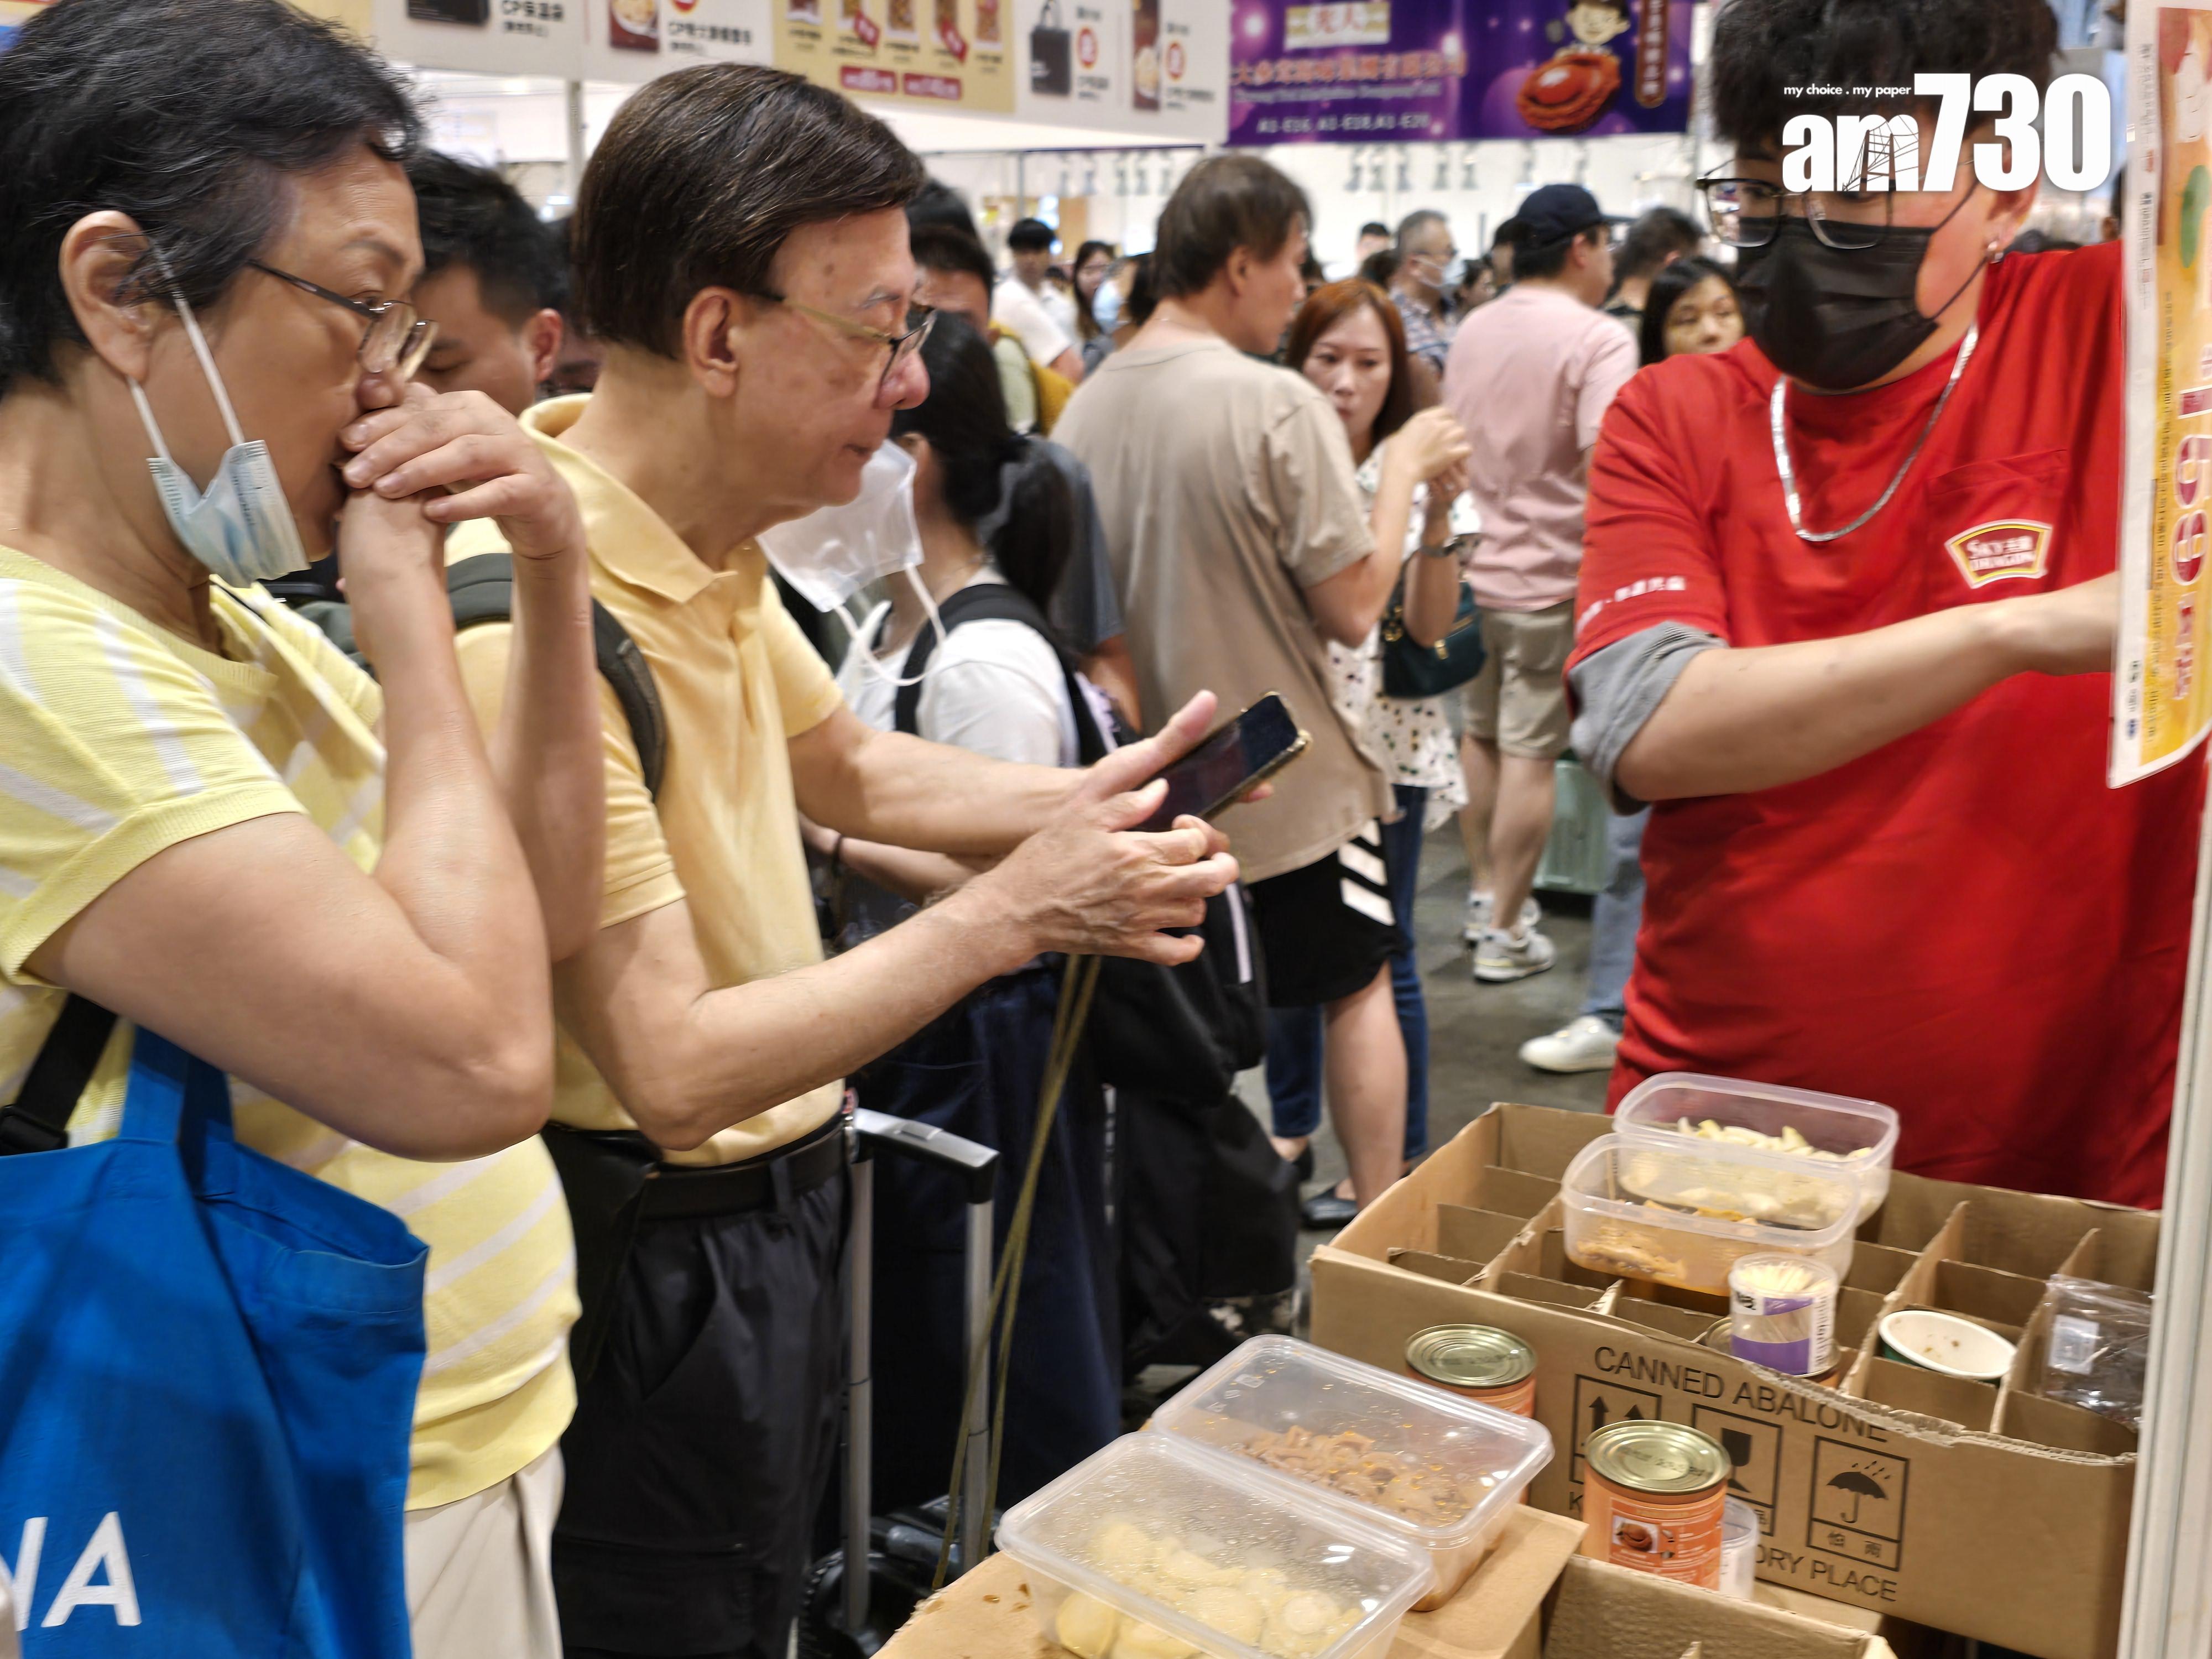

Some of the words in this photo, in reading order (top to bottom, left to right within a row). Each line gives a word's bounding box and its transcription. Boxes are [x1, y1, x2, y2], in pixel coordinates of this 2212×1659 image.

[1595, 1346, 1725, 1398] CANNED
[1732, 1382, 1888, 1443] ABALONE
[1810, 1559, 1897, 1602] PLACE
